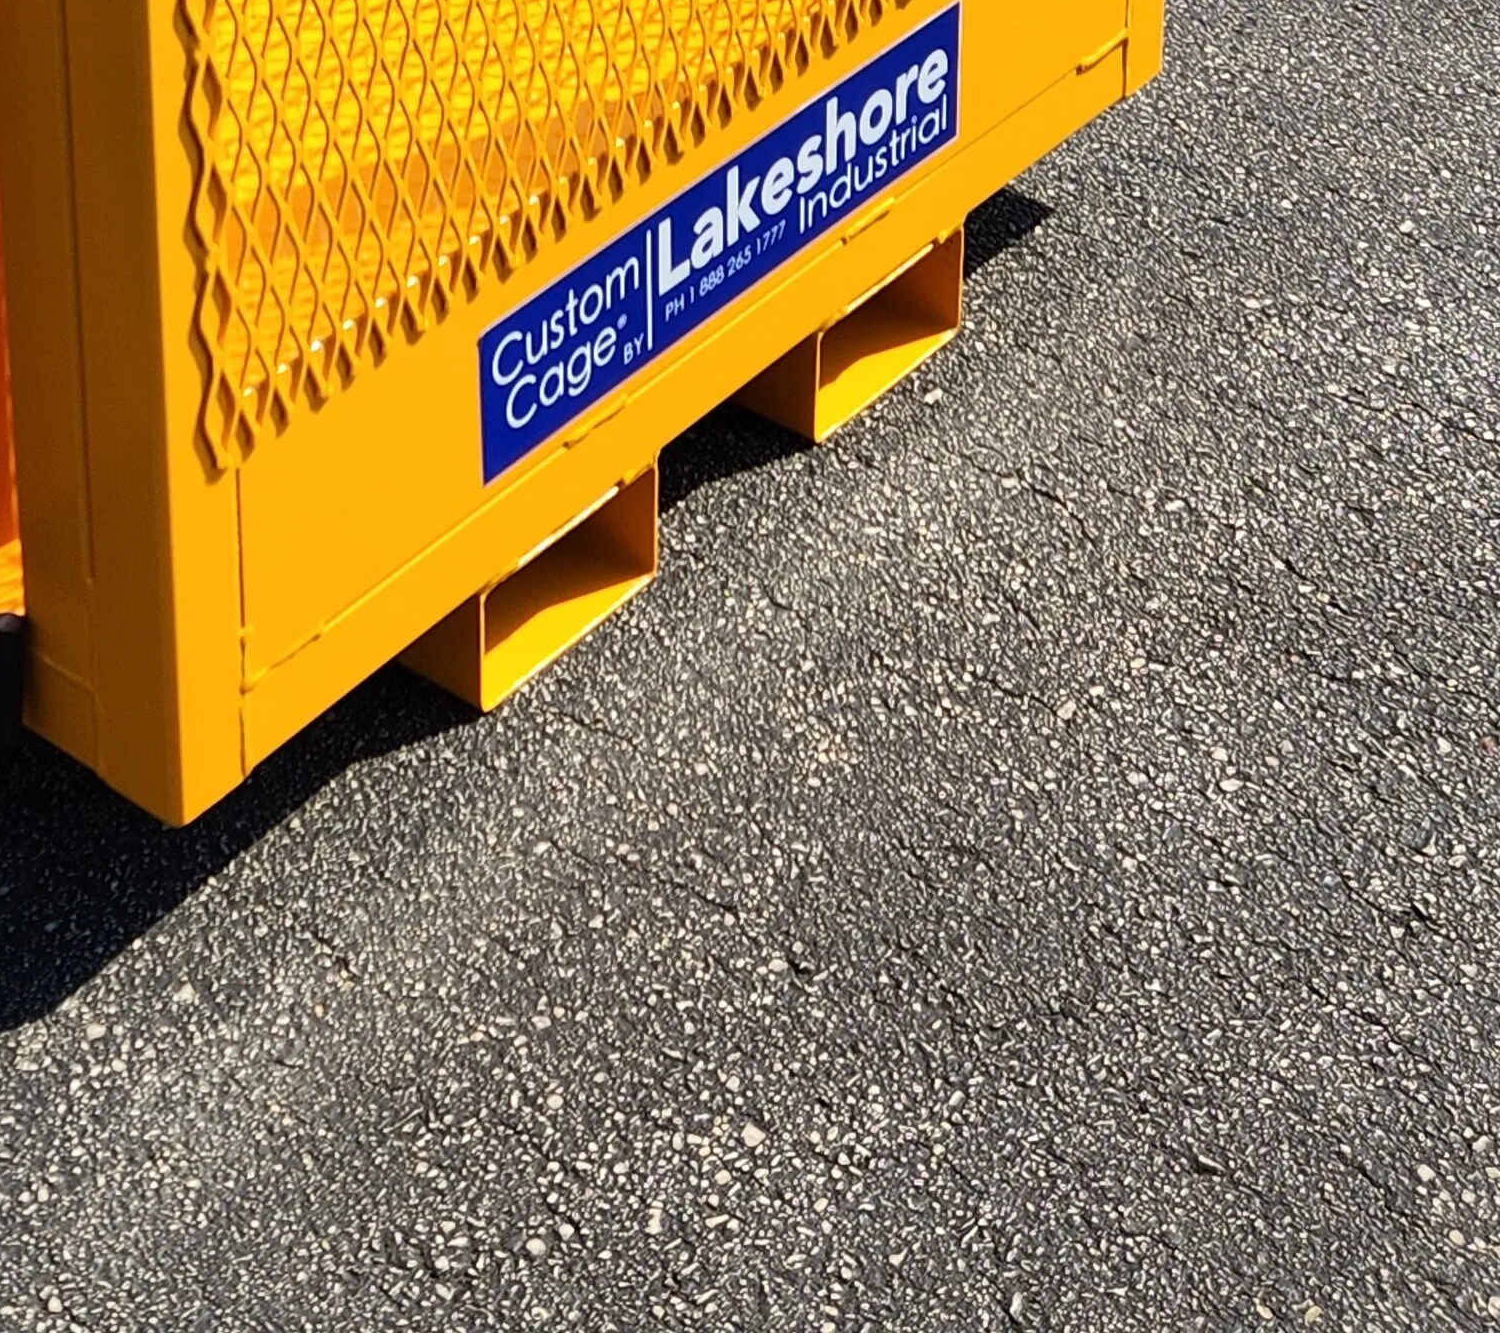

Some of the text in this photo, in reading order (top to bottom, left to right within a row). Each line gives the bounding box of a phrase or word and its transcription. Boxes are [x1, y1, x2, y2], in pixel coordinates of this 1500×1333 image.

[658, 49, 948, 296] Lakeshore
[798, 95, 947, 234] Industrial
[491, 256, 639, 386] Custom
[665, 293, 685, 322] PH
[699, 265, 725, 297] 888
[728, 245, 752, 278] 265
[755, 219, 786, 255] 1777
[623, 332, 645, 366] BY
